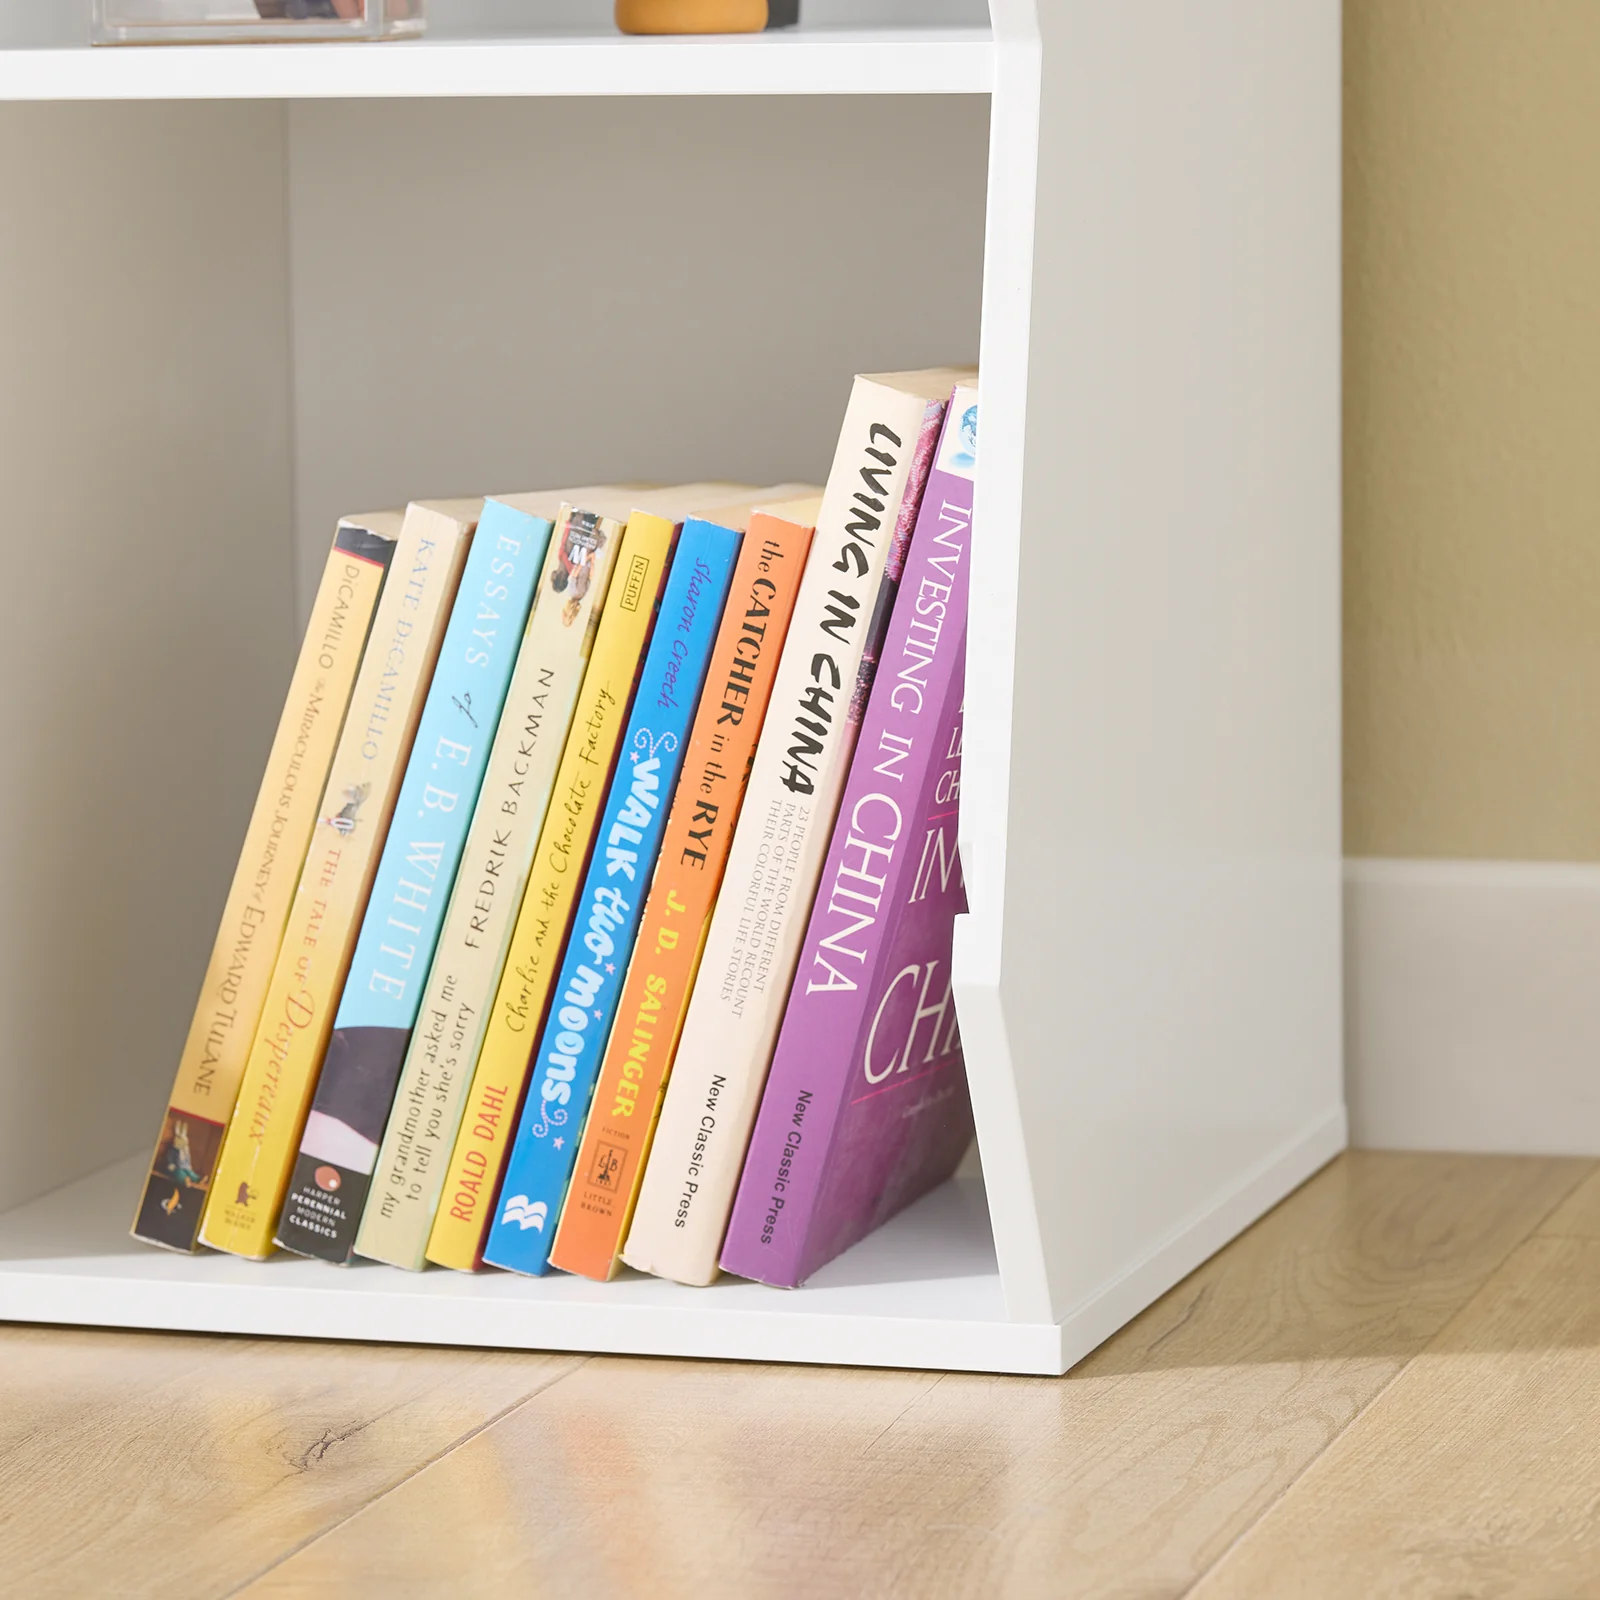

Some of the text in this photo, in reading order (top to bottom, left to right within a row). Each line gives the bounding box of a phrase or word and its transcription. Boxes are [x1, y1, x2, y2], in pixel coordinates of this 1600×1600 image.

[402, 537, 436, 611] KATE
[465, 534, 522, 668] ESSAYS
[625, 560, 645, 606] PUFFIN
[778, 422, 902, 796] LIVING IN CHINA
[431, 736, 472, 770] E.
[680, 539, 785, 871] the CATCHER in the RYE
[806, 499, 972, 996] INVESTING IN CHINA
[417, 782, 459, 818] B.
[465, 668, 555, 949] FREDRIK BACKMAN
[505, 680, 616, 1033] Charlie and the Chocolate Factory
[605, 757, 660, 882] WALK
[218, 905, 266, 1005] EDWARD
[368, 840, 445, 1000] WHITE
[720, 798, 782, 1002] THEIR COLORFUL LIFE STORIES
[732, 802, 797, 1020] PARTS OF THE WORLD RECOUNT
[753, 806, 811, 995] 23 PEOPLE FROM DIFFERENT
[193, 1009, 238, 1097] TULANE
[248, 849, 342, 1145] THE TALE OF Despereaux
[611, 889, 687, 1118] J. D. SALINGER
[381, 974, 458, 1219] my grandmother asked me
[405, 1002, 476, 1201] to tell you she's sorry
[450, 1085, 509, 1223] ROALD DAHL
[602, 1126, 630, 1140] FICTION
[674, 1073, 727, 1229] New Classic Press
[760, 1089, 814, 1245] New Classic Press
[289, 1214, 338, 1239] CLASSICS
[291, 1192, 347, 1219] PERENNIAL
[296, 1206, 336, 1227] MODERN
[303, 1186, 341, 1205] HARPER
[581, 1201, 612, 1217] BROWN
